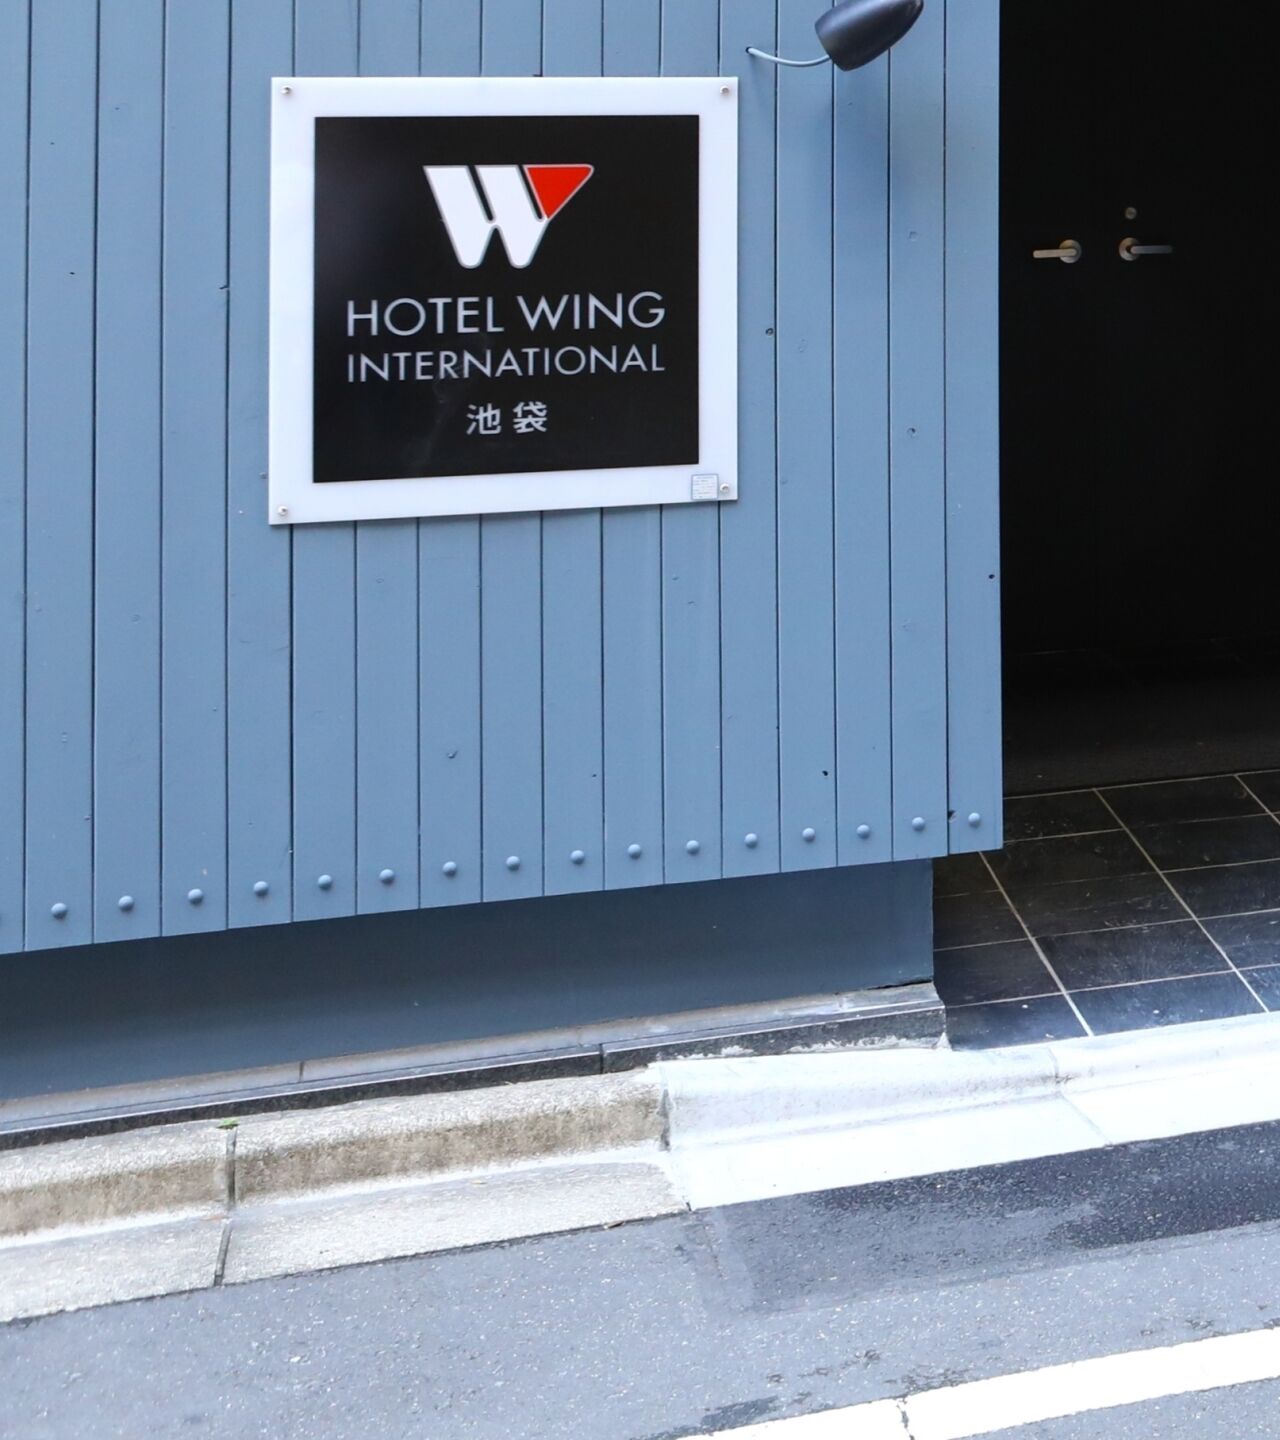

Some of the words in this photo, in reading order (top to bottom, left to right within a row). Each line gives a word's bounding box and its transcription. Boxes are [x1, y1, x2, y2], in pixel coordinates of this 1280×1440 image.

[346, 296, 505, 337] HOTEL
[516, 291, 667, 332] WING
[346, 344, 666, 383] INTERNATIONAL
[466, 401, 549, 436] 池袋
